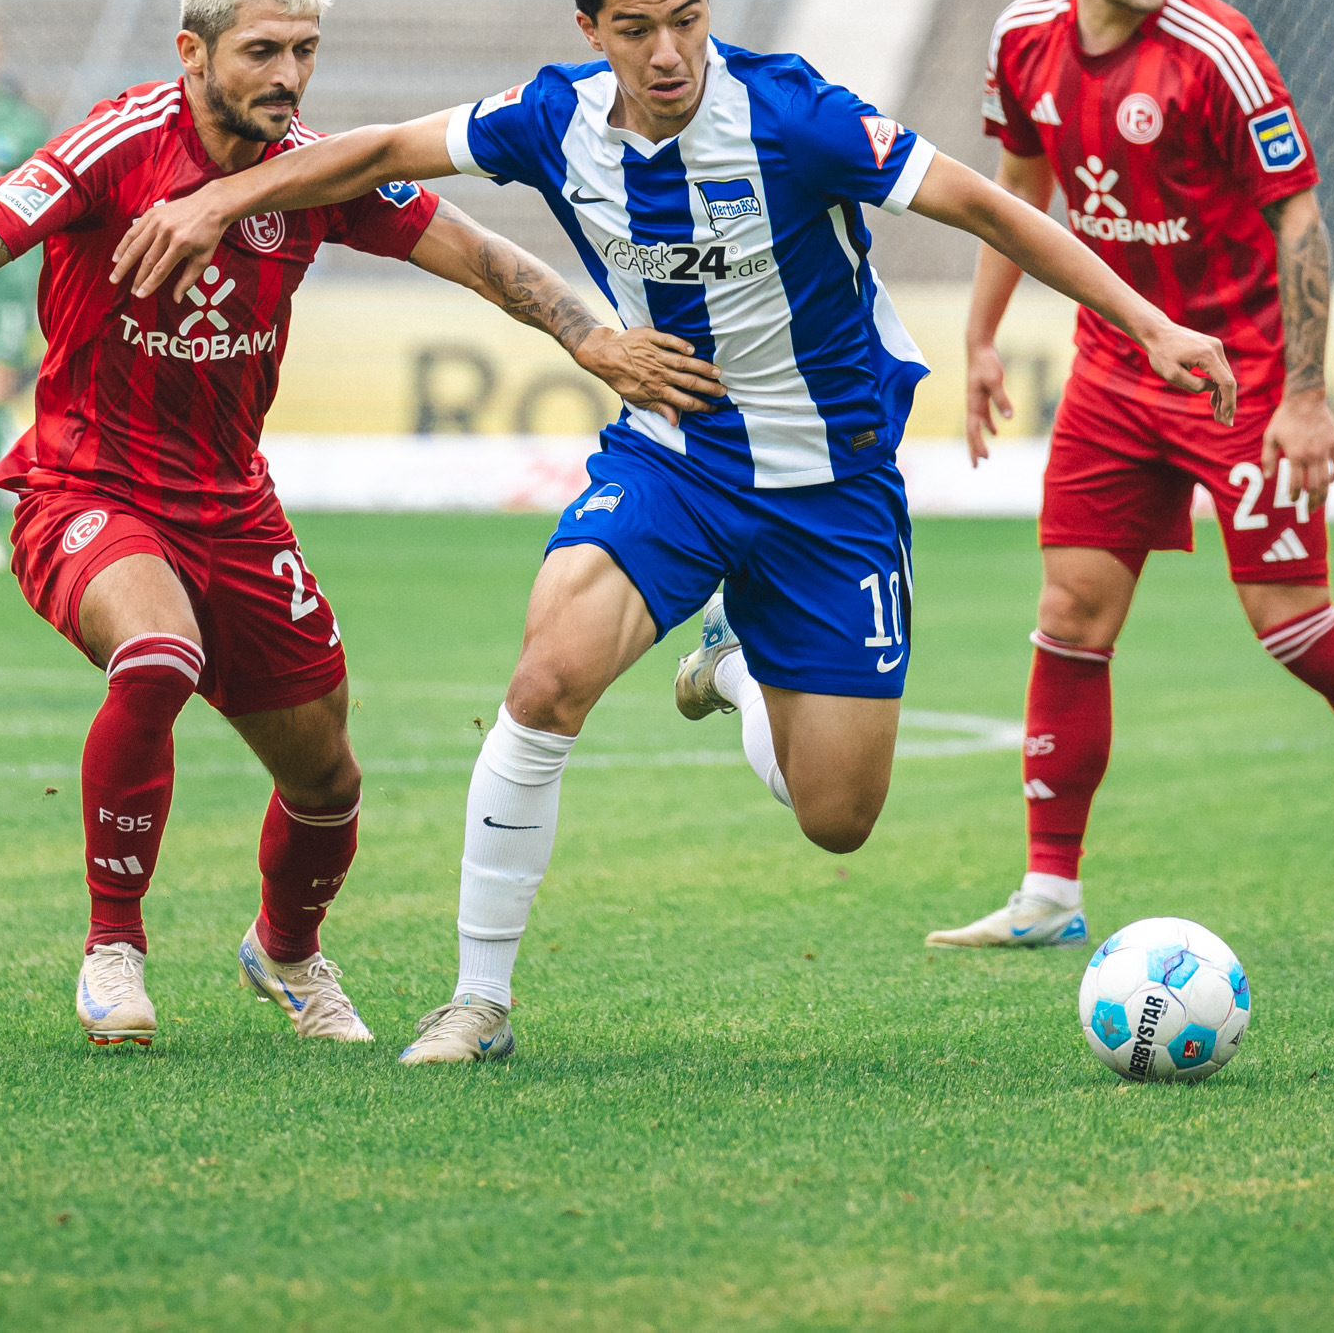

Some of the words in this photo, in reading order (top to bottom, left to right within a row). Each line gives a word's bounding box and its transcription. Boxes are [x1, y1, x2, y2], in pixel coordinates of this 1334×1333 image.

[615, 252, 666, 279] CARS
[1228, 457, 1310, 531] 24
[272, 541, 323, 622] 2
[860, 572, 903, 647] 10
[1025, 733, 1056, 756] 95
[311, 871, 346, 888] F9
[1128, 995, 1164, 1077] DERBYSTAR
